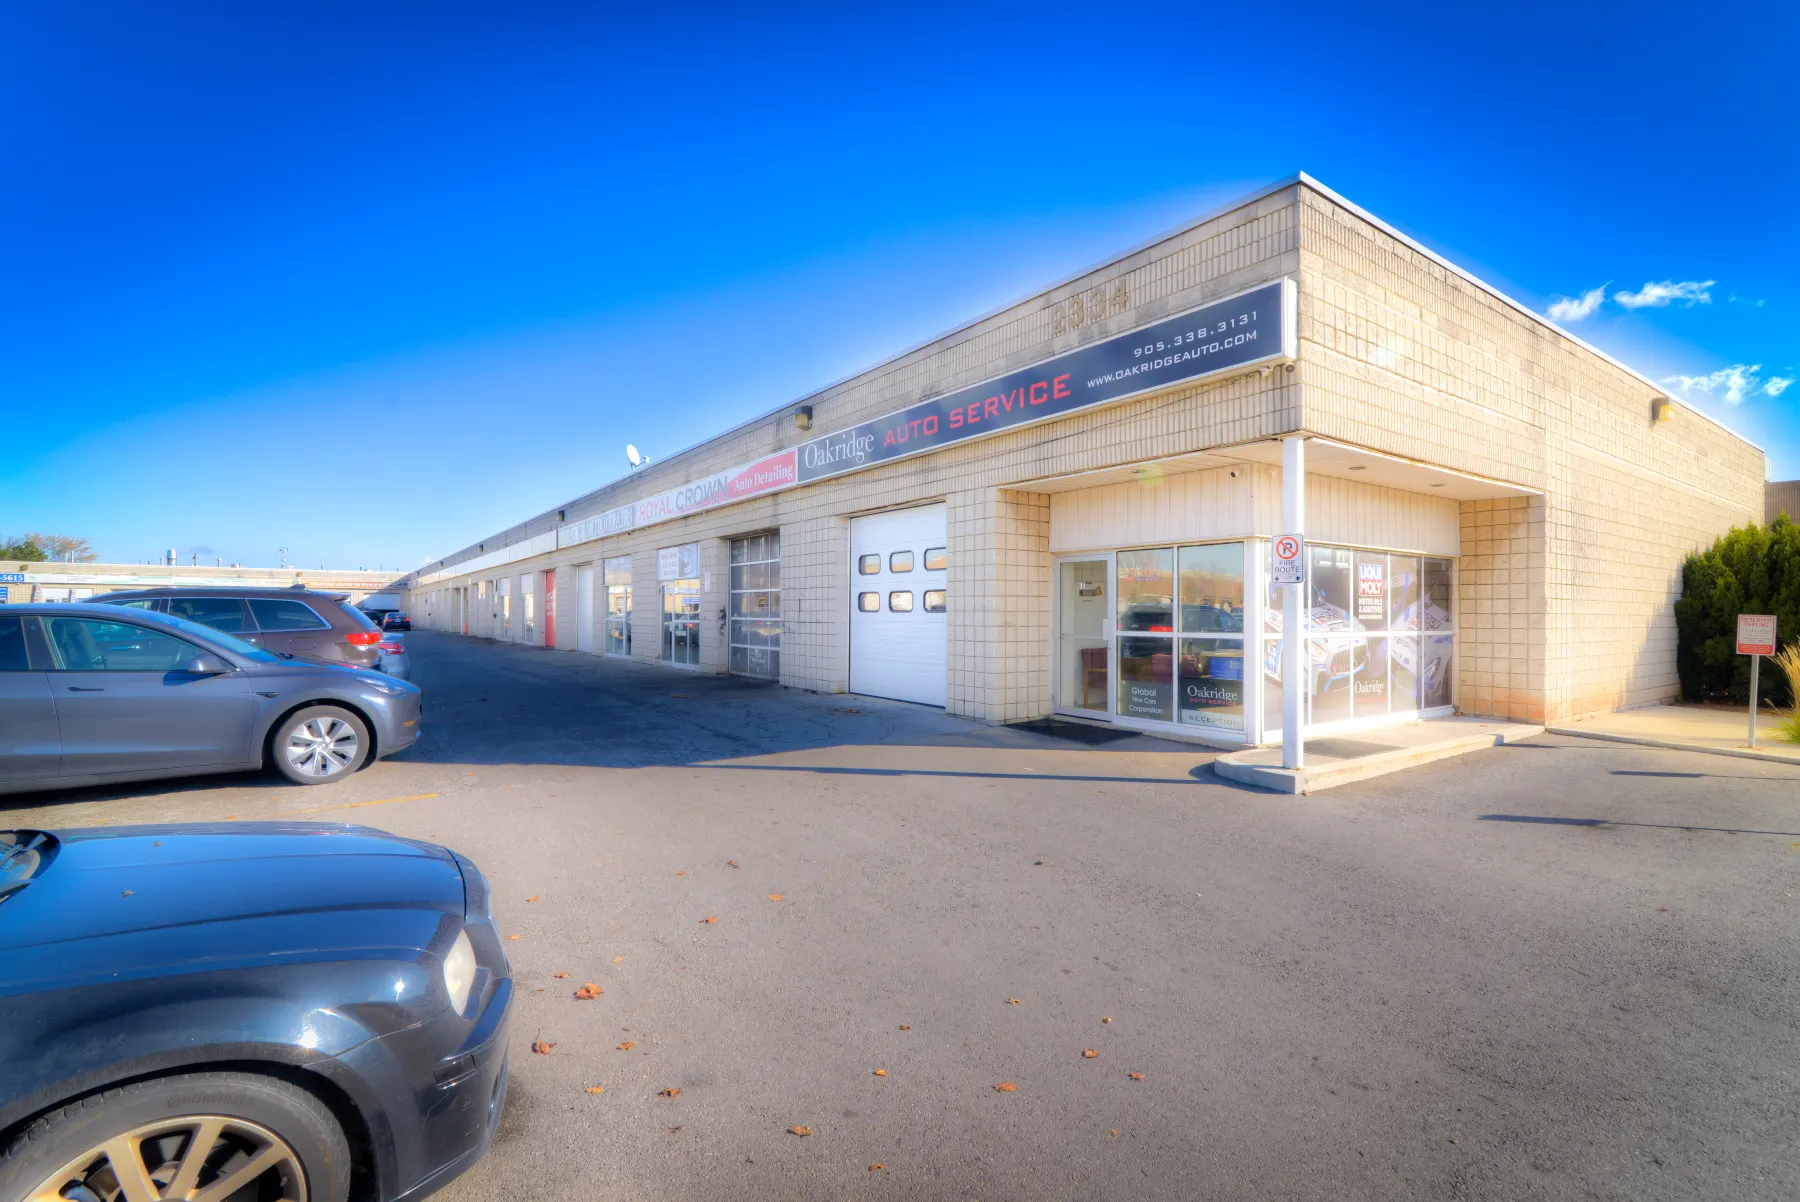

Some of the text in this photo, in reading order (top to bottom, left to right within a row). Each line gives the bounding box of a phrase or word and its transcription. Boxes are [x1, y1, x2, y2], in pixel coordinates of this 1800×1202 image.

[1051, 278, 1129, 335] 2334
[1134, 311, 1257, 358] 905.338.3131
[1087, 330, 1257, 389] WWW.OAKRIDGEAUTO.COM
[805, 373, 1071, 469] Oakridge AUTO SERVICE
[734, 465, 793, 493] Auto Detailing
[639, 475, 728, 521] ROYAL CROWN
[604, 507, 633, 533] REPAIRS
[1274, 565, 1301, 574] ROUTE
[1279, 559, 1296, 567] FIRE
[1360, 565, 1382, 580] LIQUI
[1360, 580, 1383, 595] MOLY
[1131, 687, 1157, 697] Global
[1187, 685, 1238, 701] Oakridge
[1128, 705, 1164, 714] Corporation
[1189, 715, 1240, 726] RECEPTION
